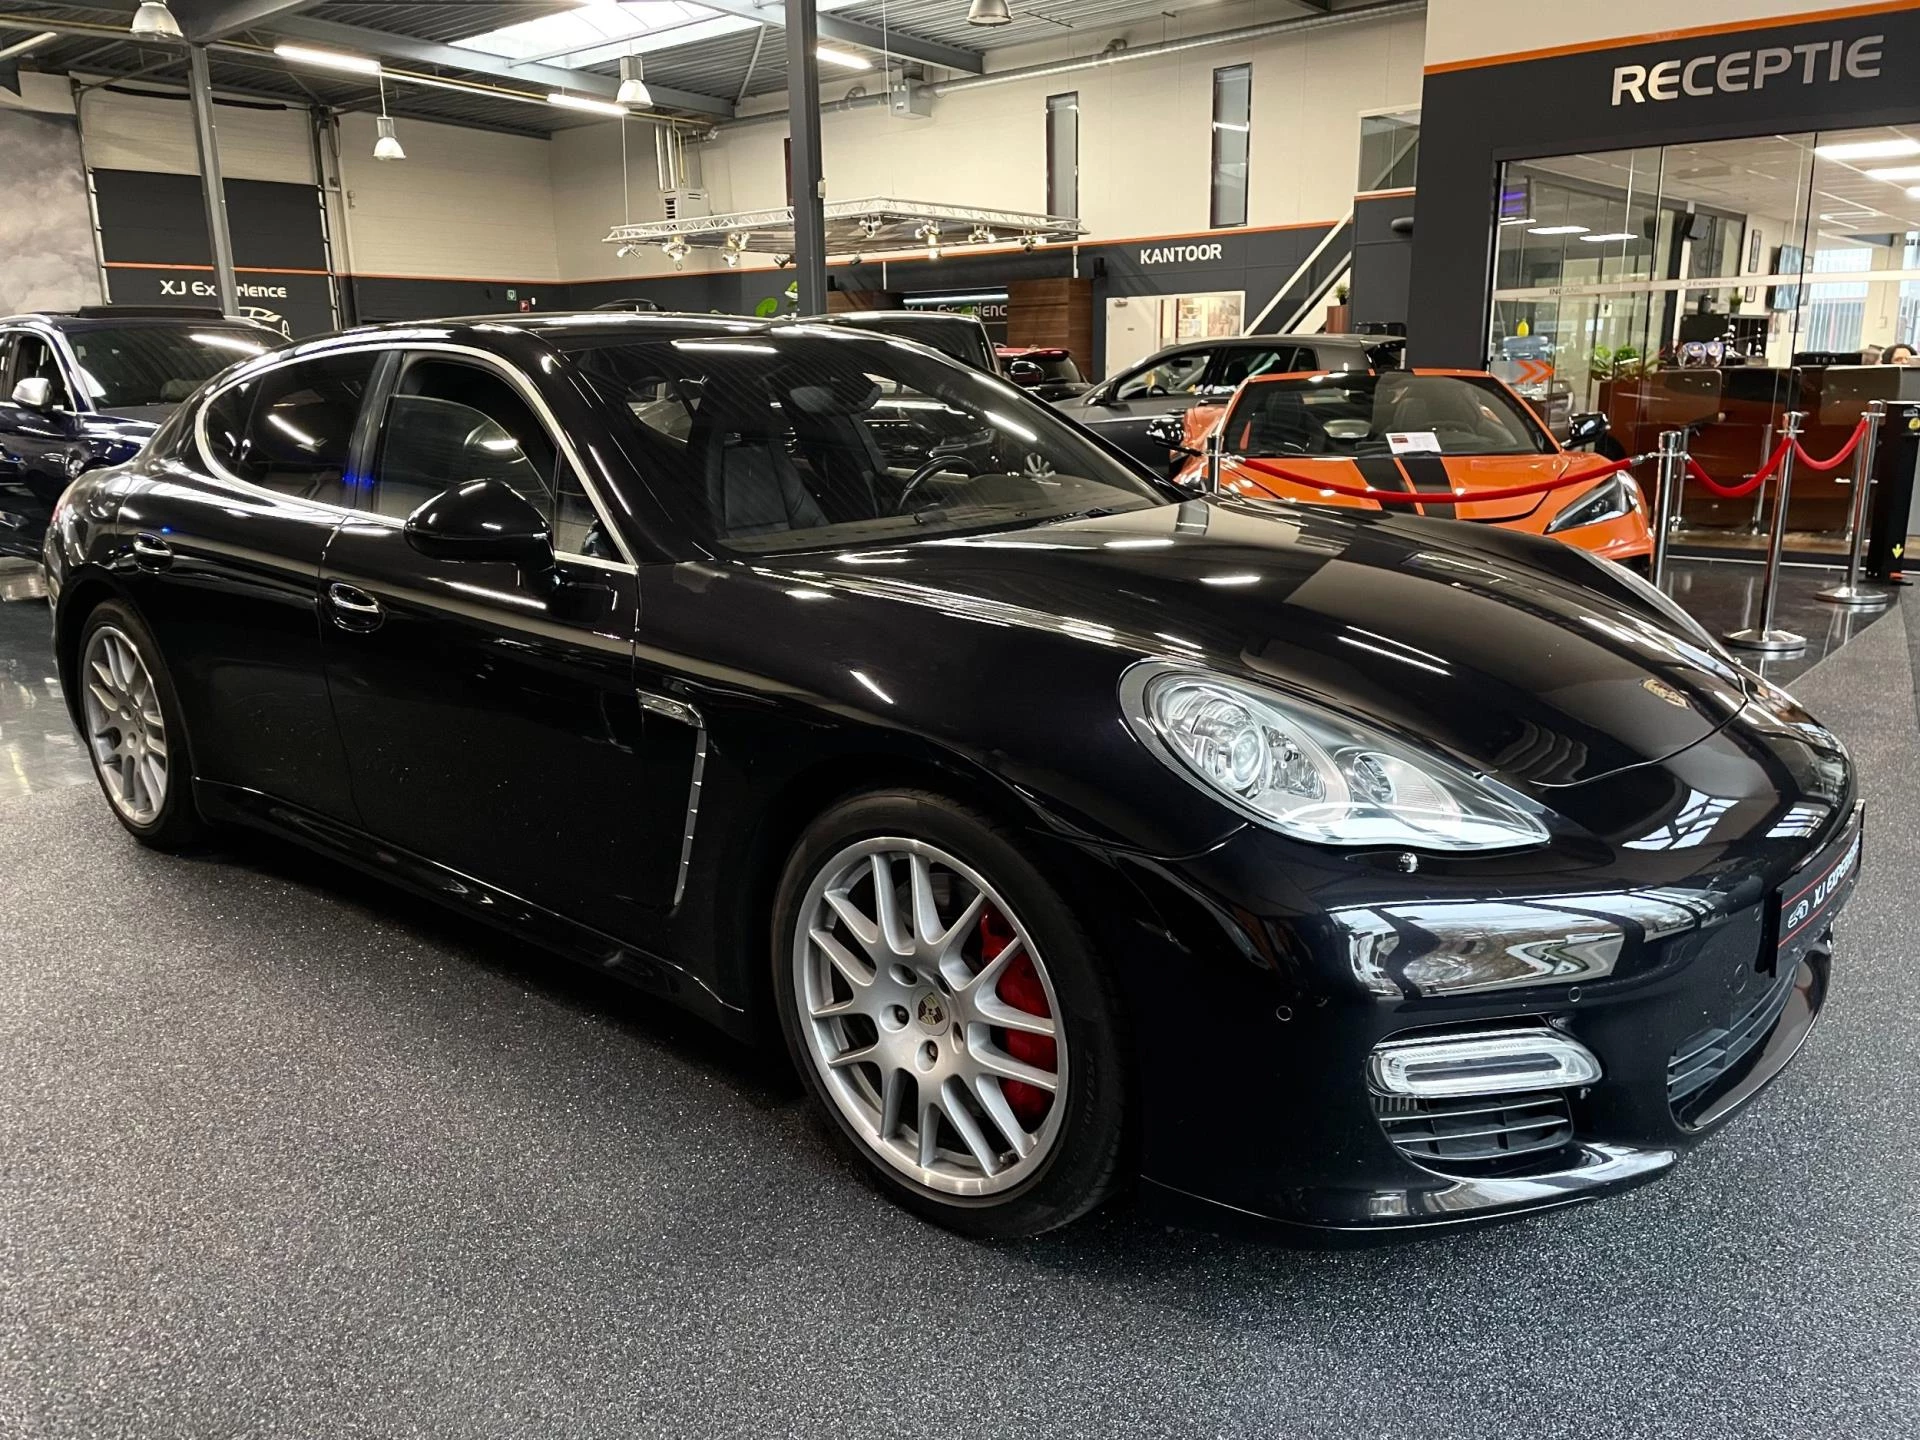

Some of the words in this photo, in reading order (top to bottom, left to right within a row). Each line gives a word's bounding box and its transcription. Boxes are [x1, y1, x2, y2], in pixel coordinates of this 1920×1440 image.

[1611, 35, 1884, 106] RECEPTIE
[1140, 243, 1222, 265] KANTOOR
[160, 280, 187, 295] XJ
[191, 281, 288, 298] Exrience
